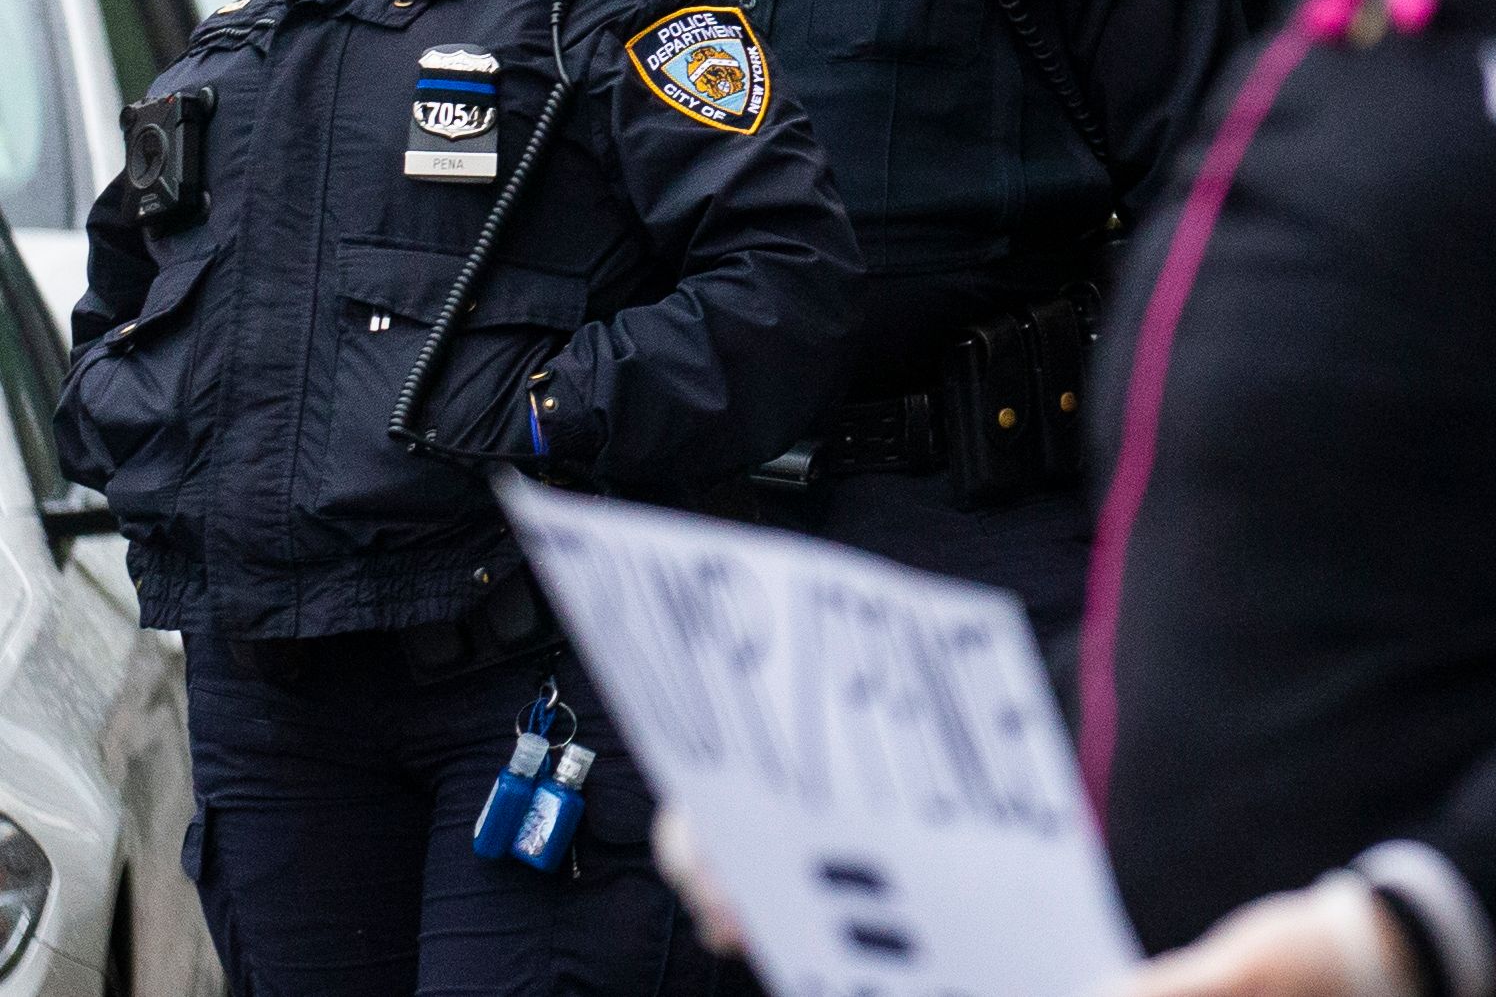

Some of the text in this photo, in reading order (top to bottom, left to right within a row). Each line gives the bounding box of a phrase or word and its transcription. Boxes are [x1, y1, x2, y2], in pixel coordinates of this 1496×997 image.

[646, 24, 744, 71] DEPARTMENT
[657, 12, 718, 44] POLICE
[663, 45, 765, 120] CITY OF NEW YORK
[433, 157, 465, 171] PENA
